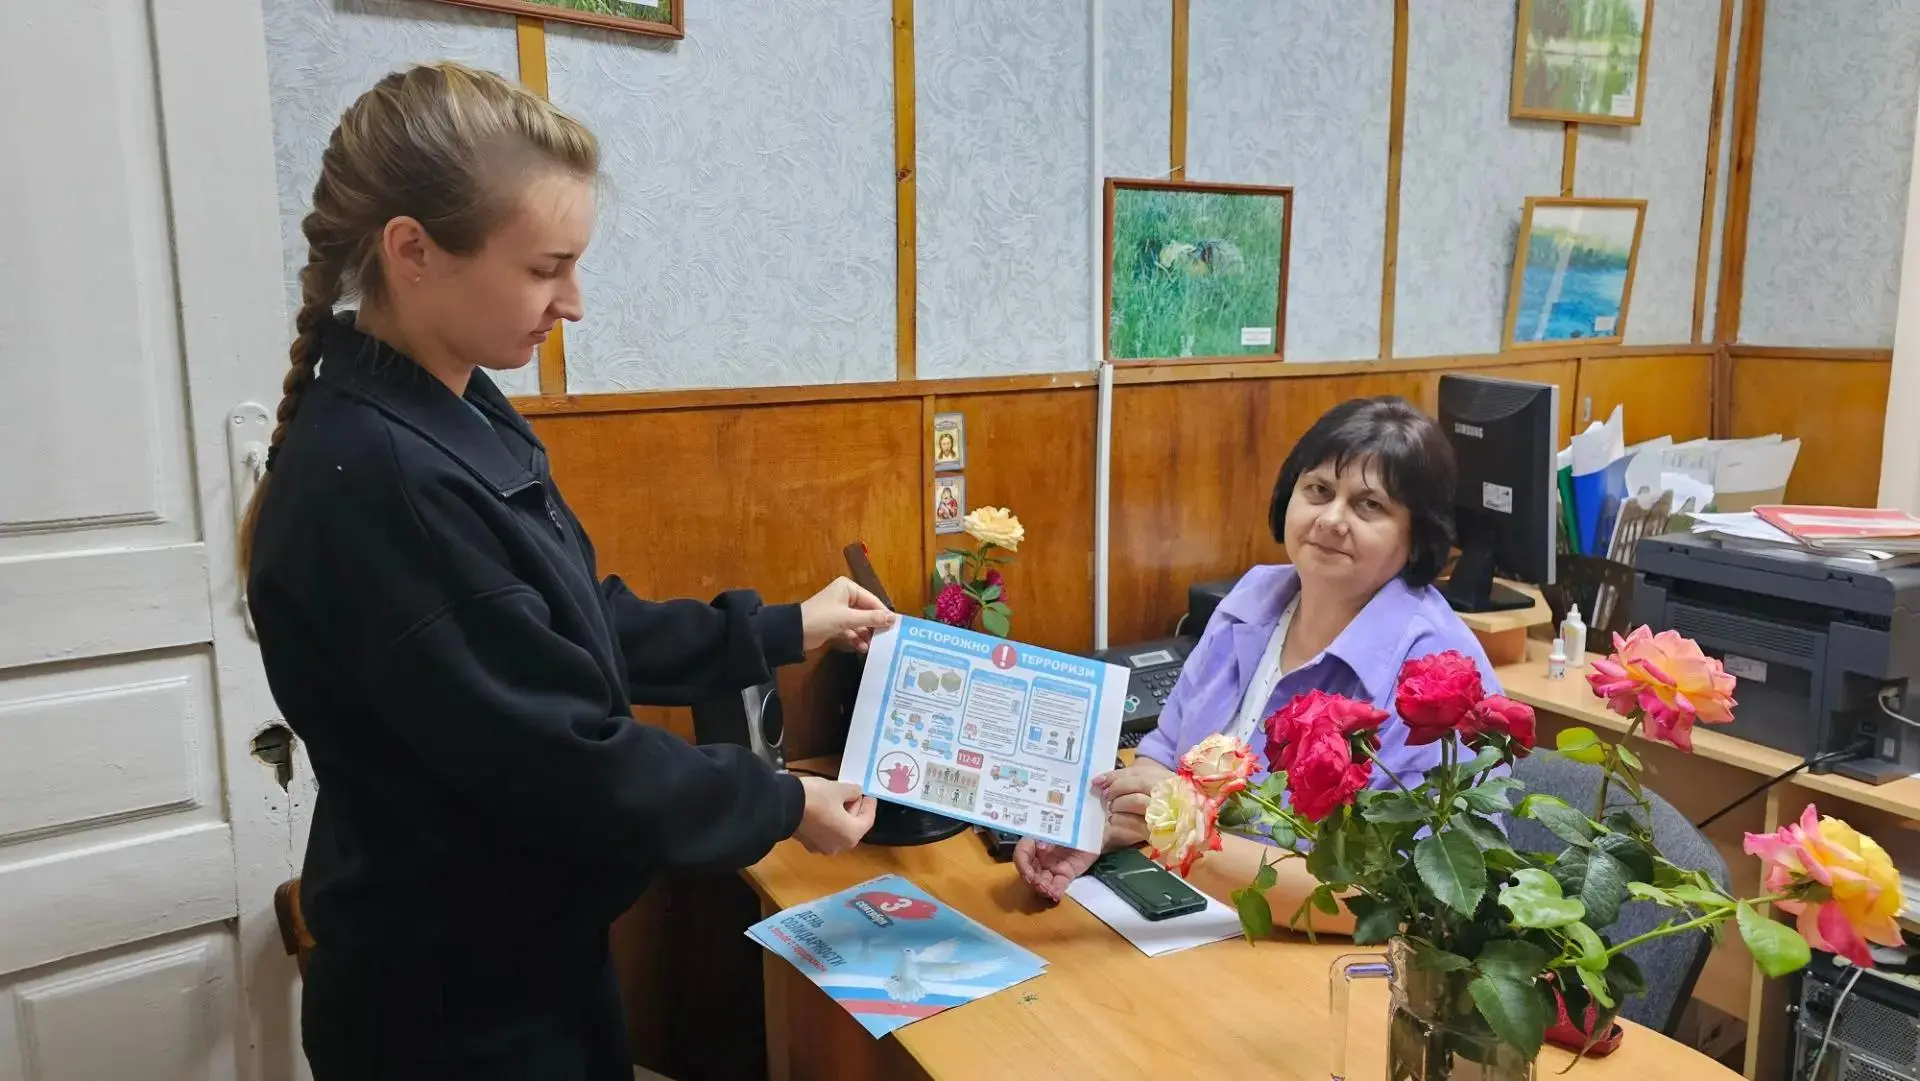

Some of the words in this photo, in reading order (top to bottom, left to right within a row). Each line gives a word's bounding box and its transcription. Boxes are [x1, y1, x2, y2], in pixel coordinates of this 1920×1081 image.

[1454, 422, 1484, 439] SAMSUNG
[908, 626, 991, 654] ОСТОРОЖНО
[1021, 652, 1097, 678] ТЕРРОРИЗМ
[880, 898, 913, 912] 3
[794, 910, 825, 929] ДЕНЬ
[780, 916, 848, 968] СОЛИДАРНОСТИ
